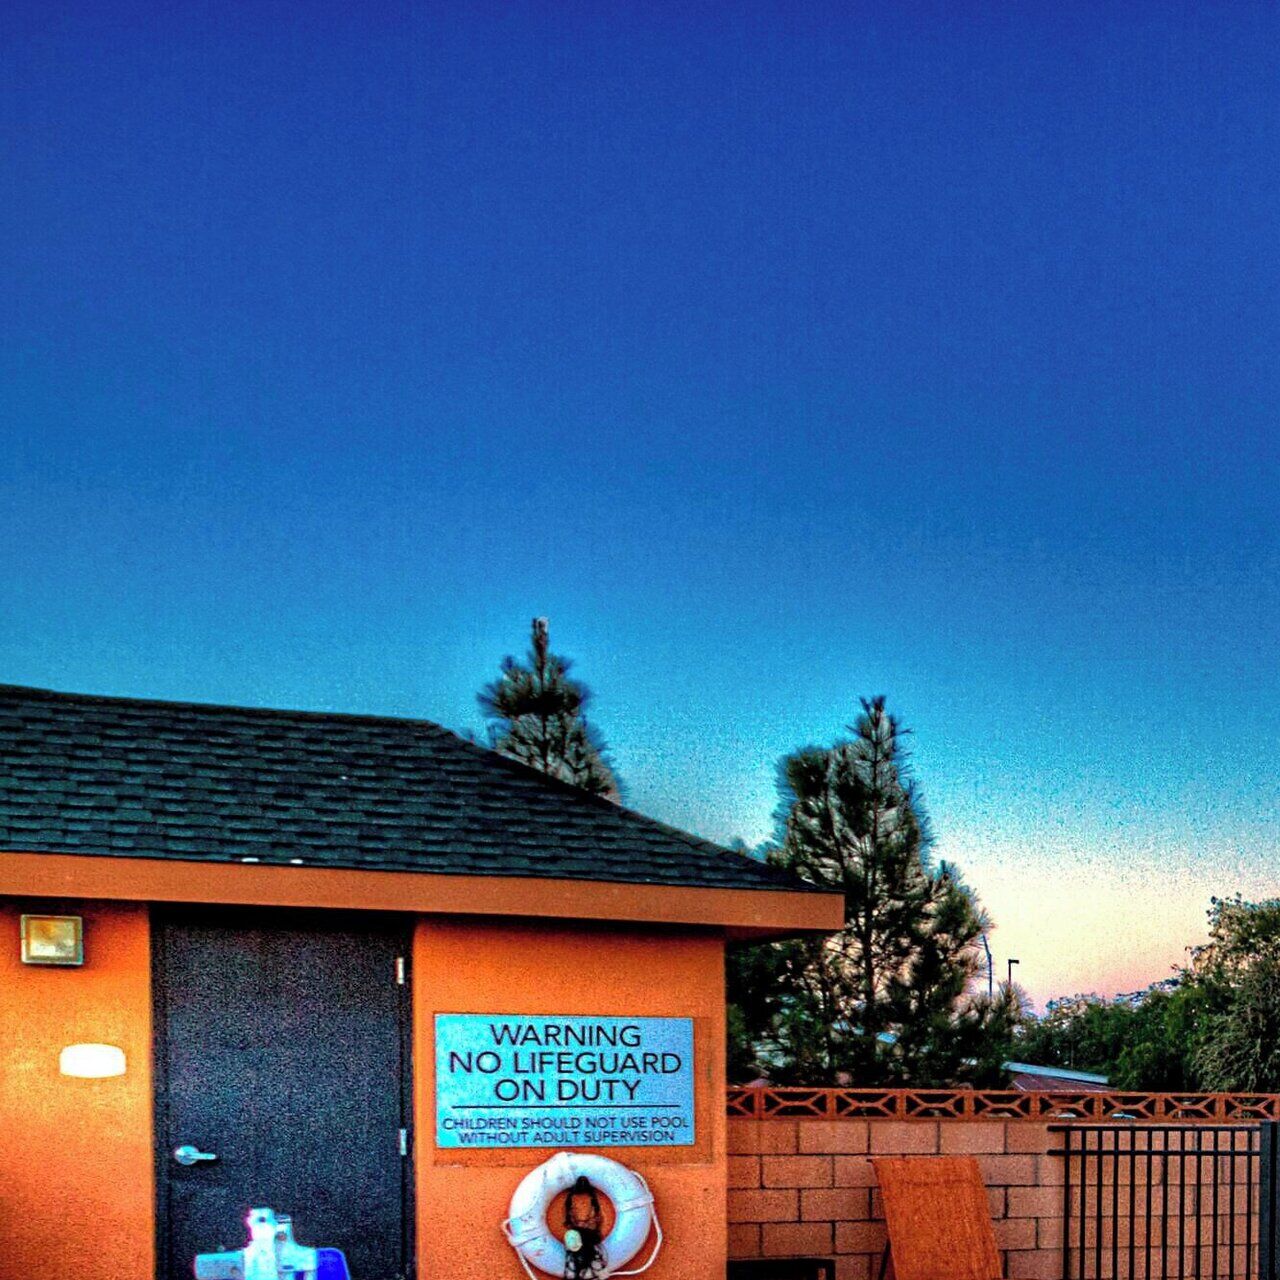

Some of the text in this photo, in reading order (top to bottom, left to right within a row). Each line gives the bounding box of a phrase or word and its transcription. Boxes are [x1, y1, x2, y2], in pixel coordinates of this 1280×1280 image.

[490, 1024, 642, 1047] WARNING
[449, 1051, 682, 1074] NO LIFEGUARD
[495, 1079, 642, 1101] ON DUTY
[443, 1117, 689, 1130] CHILDREN SHOULD NOT USE POOL
[459, 1130, 674, 1144] WITHOUT ADULT SUPERVISION
